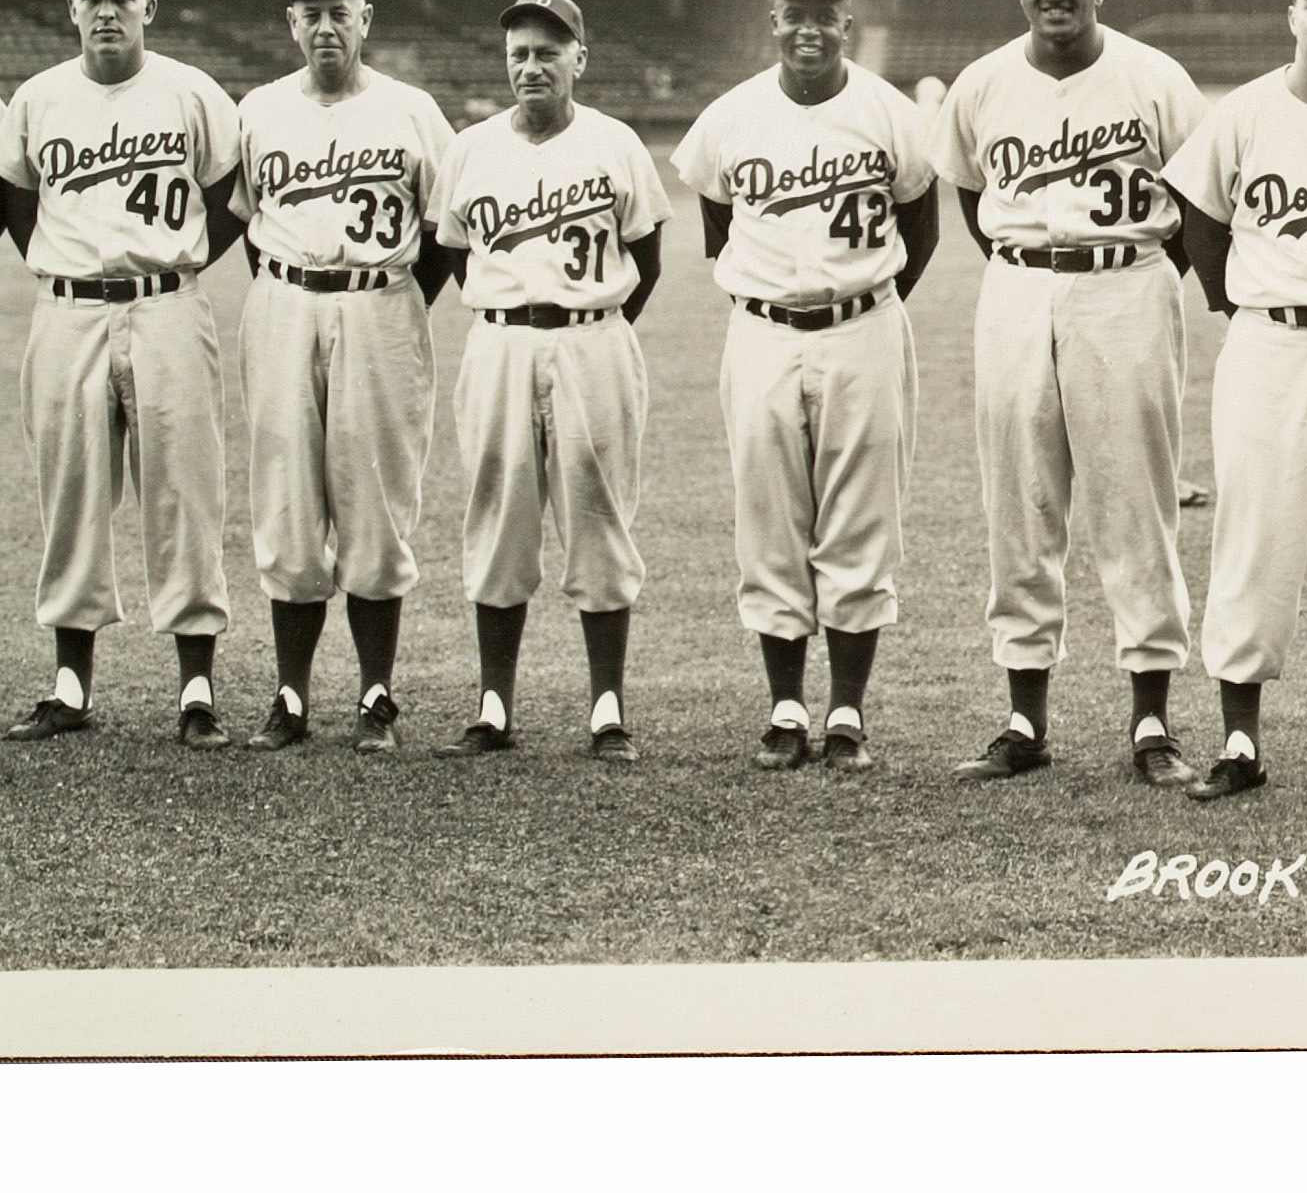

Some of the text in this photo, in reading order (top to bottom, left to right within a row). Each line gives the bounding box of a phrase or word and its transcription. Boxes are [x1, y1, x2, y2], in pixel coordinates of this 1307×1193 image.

[39, 123, 188, 195] Dodgers
[257, 139, 406, 210] Dodgers
[732, 146, 890, 218] Dodgers
[987, 118, 1148, 190] Dodgers
[125, 173, 190, 231] 40
[343, 189, 404, 250] 33
[466, 175, 617, 253] Dodgers
[826, 192, 888, 250] 42
[1087, 168, 1153, 227] 36
[560, 225, 606, 282] 31
